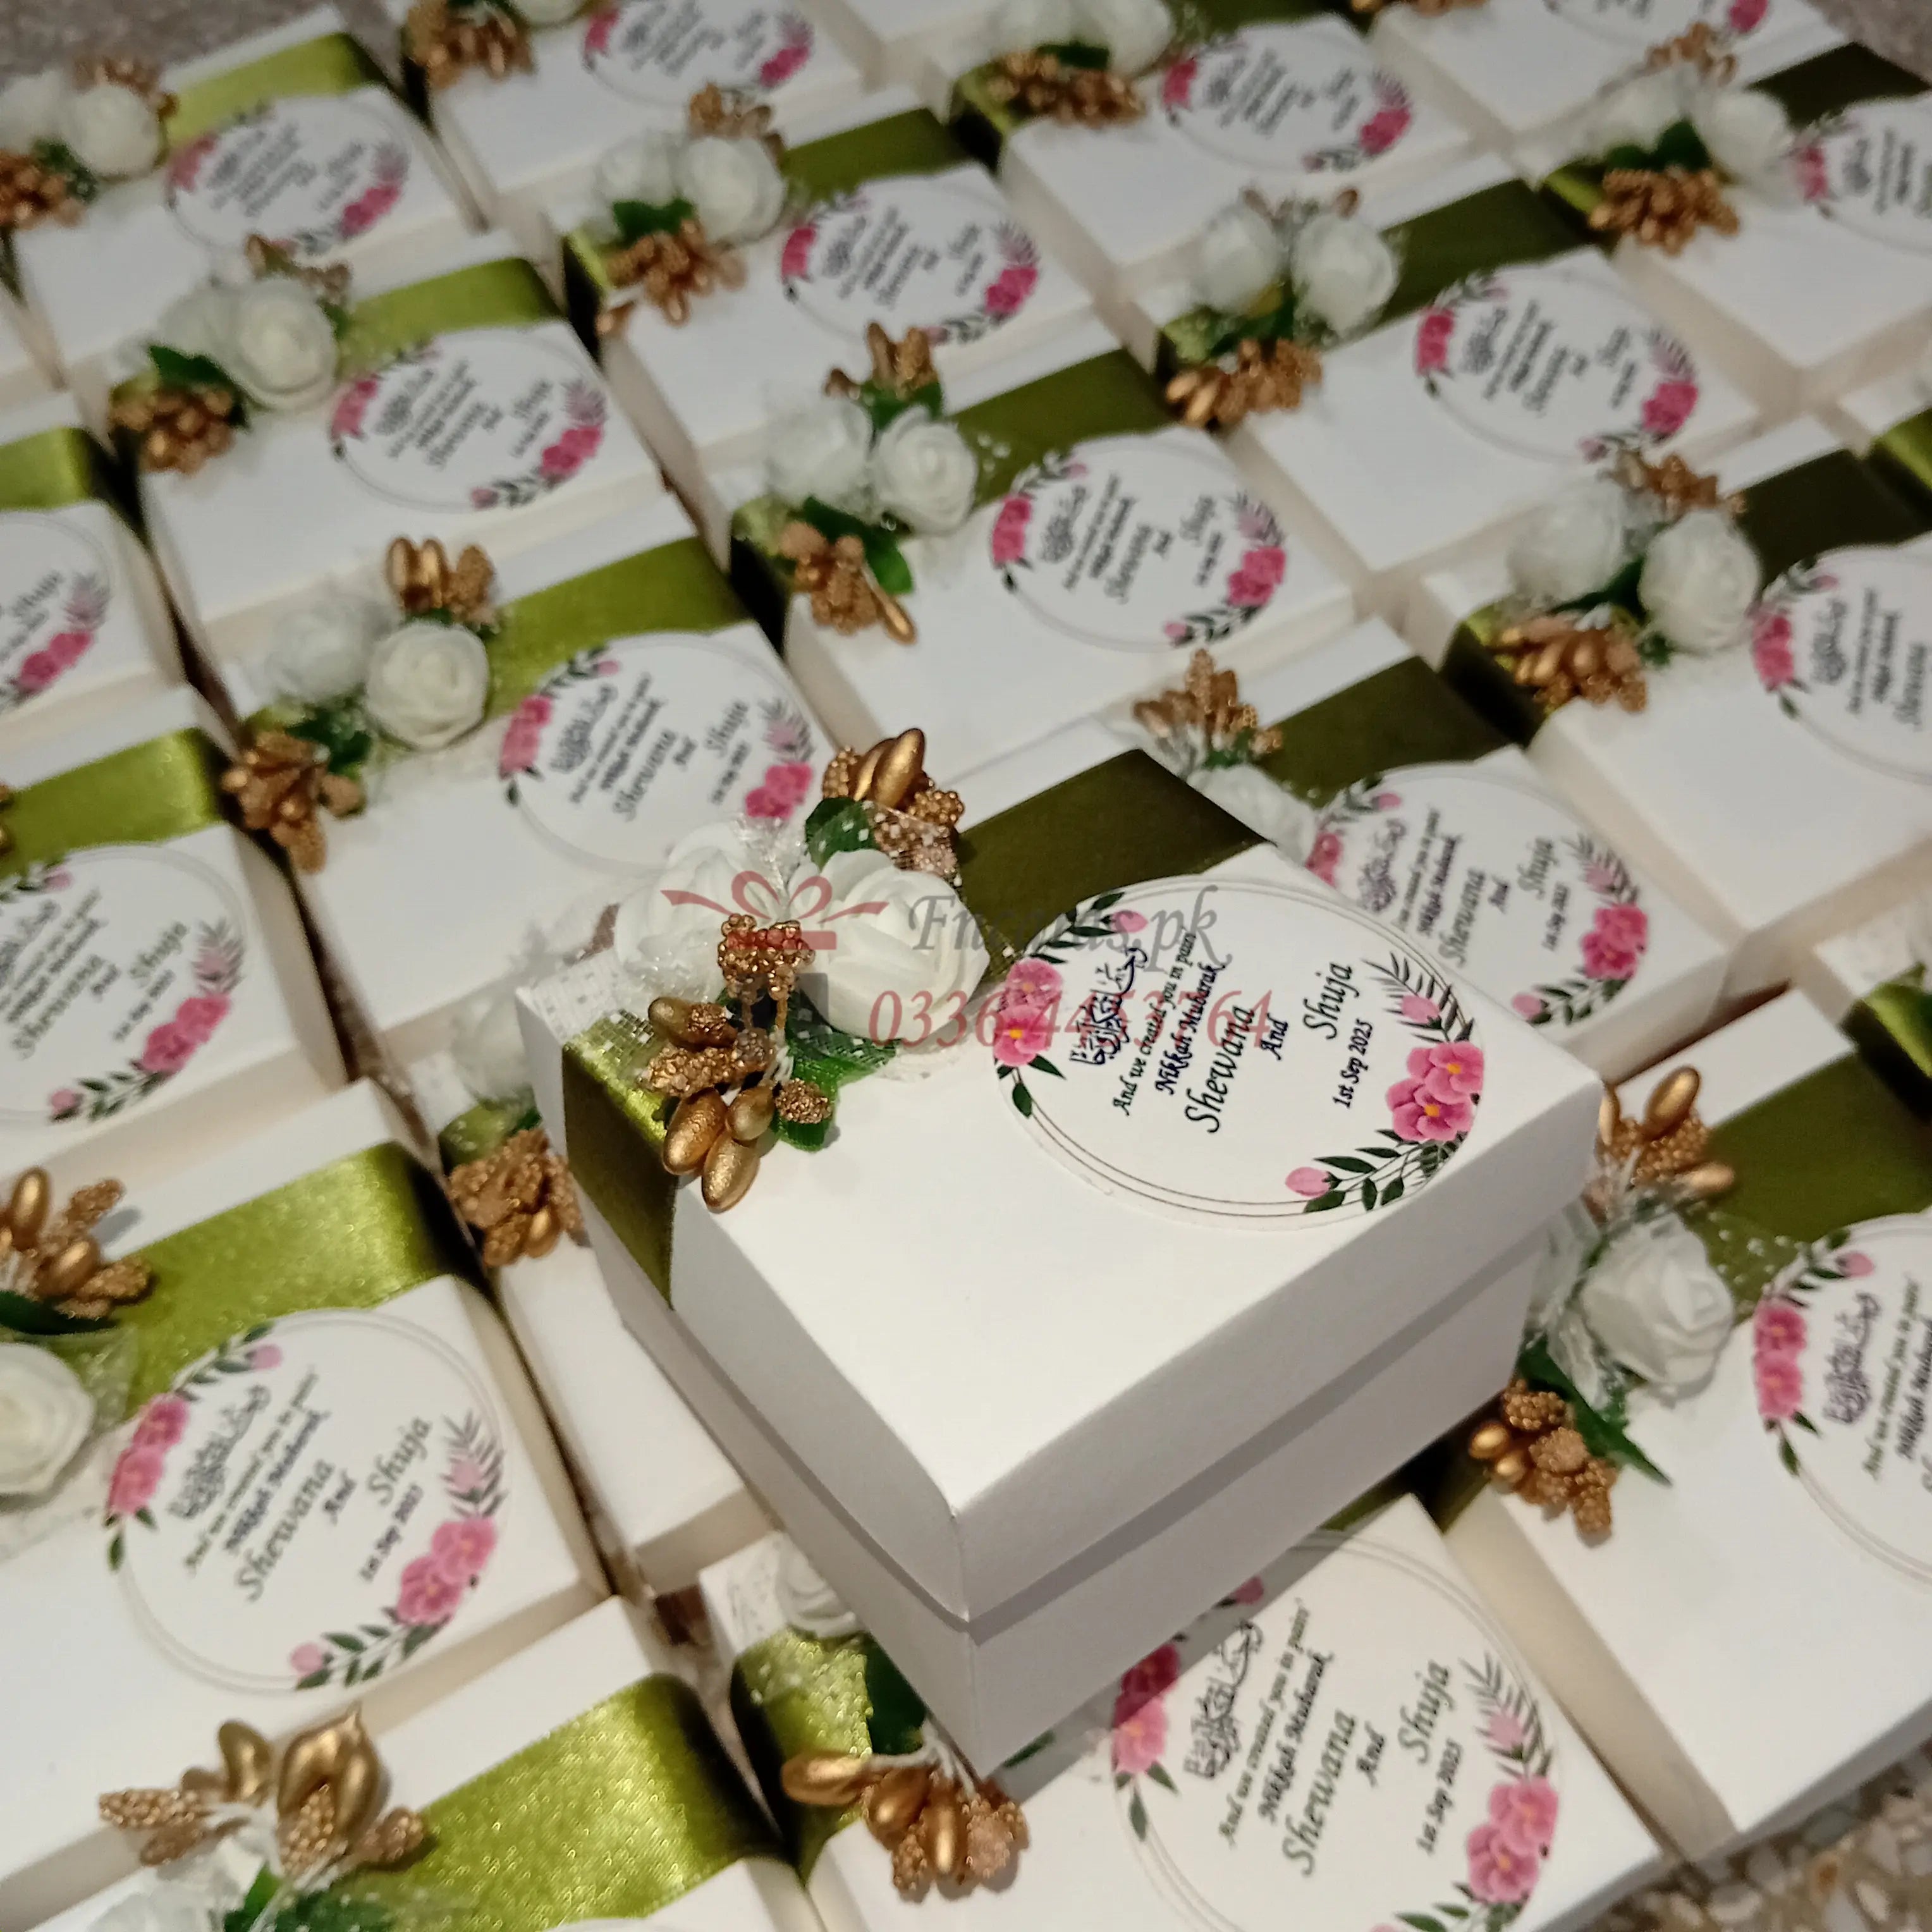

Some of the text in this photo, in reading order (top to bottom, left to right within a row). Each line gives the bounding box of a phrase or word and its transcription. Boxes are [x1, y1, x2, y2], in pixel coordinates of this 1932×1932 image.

[1113, 1075, 1137, 1116] And
[1130, 1058, 1147, 1077] we
[1139, 1003, 1167, 1056] created
[1158, 982, 1177, 1010] you
[1170, 965, 1184, 980] in
[1260, 1013, 1288, 1061] And
[1303, 963, 1360, 1040] Shuja
[1155, 1032, 1193, 1096] Nikkah
[1184, 1006, 1257, 1134] Shewana
[1333, 1085, 1354, 1108] 1st
[1340, 1057, 1369, 1084] Sep
[367, 1417, 431, 1508] Shuja
[236, 1459, 334, 1602] Shewana
[1396, 1661, 1454, 1764] Shuja
[1282, 1711, 1356, 1876] Shewana
[1356, 1724, 1386, 1786] And
